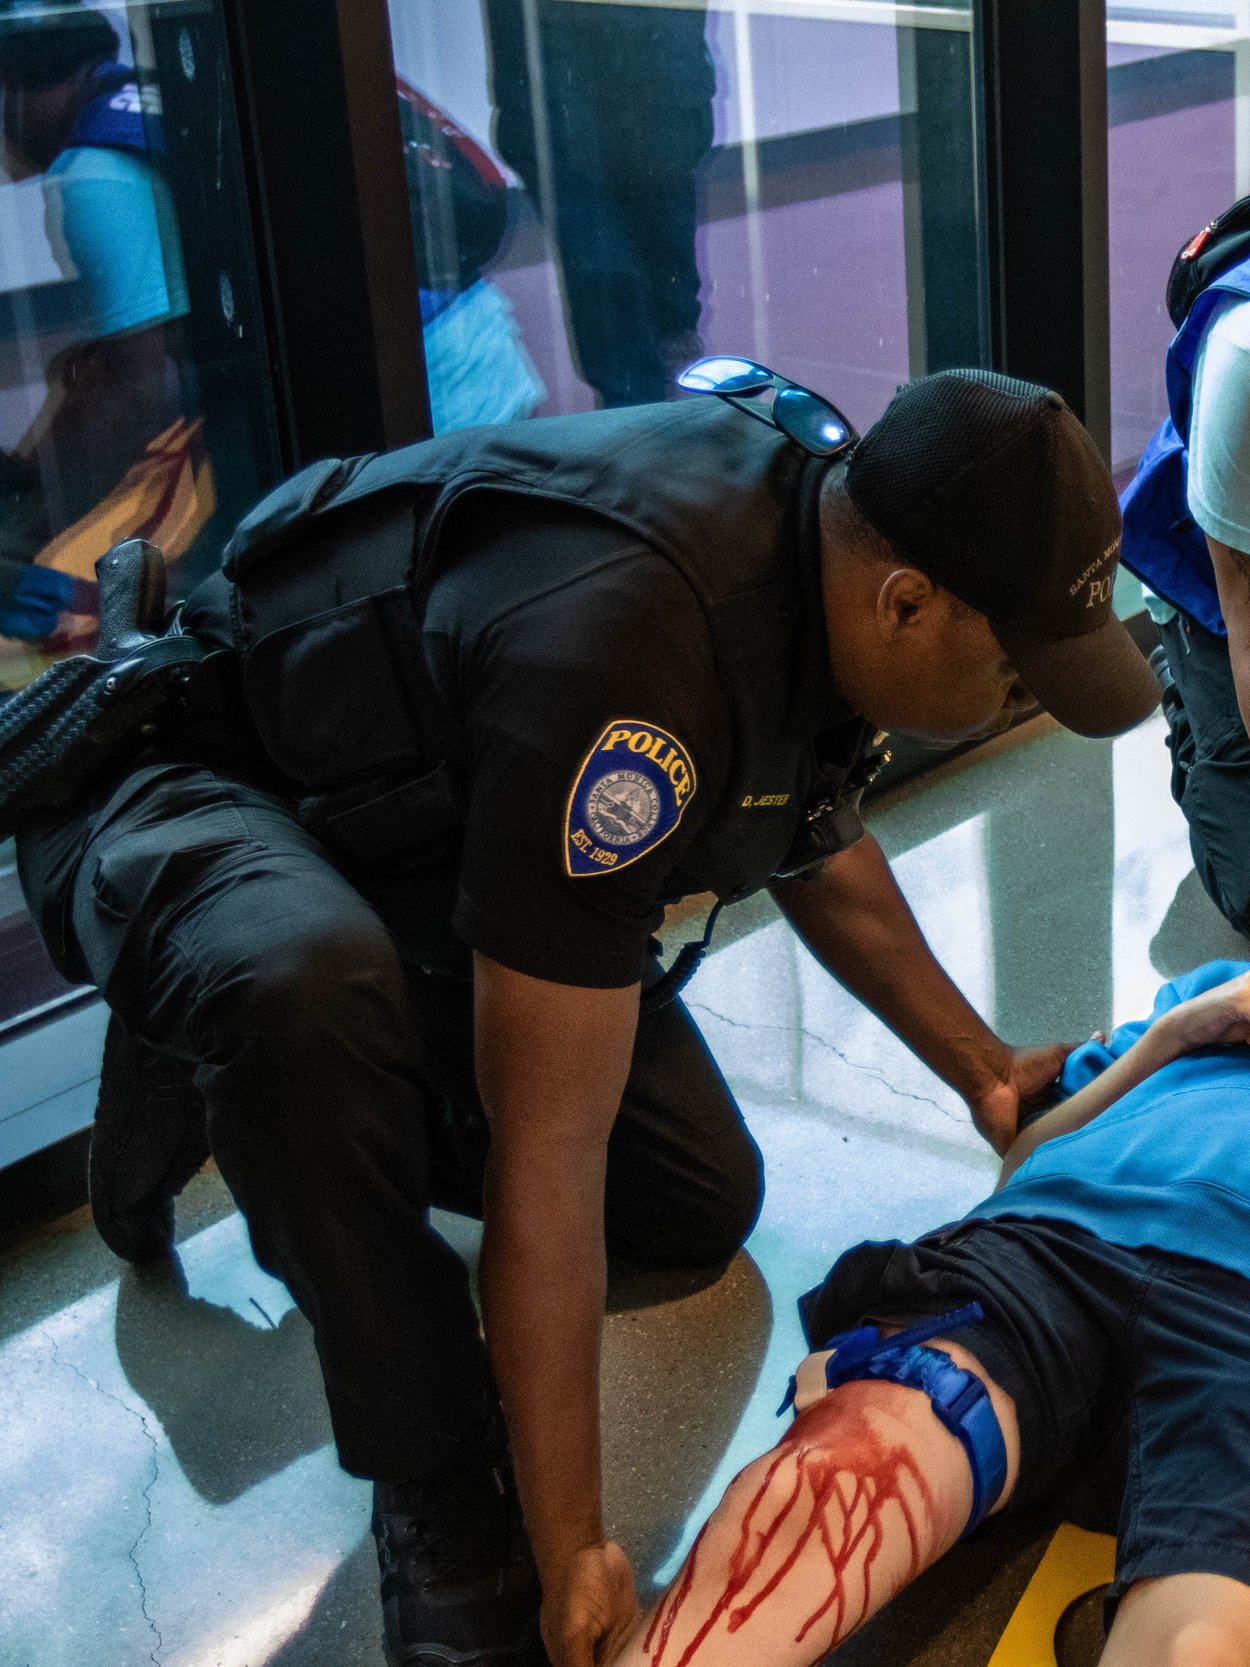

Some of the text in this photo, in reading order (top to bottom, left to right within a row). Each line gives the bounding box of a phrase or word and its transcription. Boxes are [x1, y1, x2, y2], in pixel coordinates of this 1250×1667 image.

[1069, 538, 1120, 595] SANTA MON
[1086, 576, 1111, 608] PO
[601, 730, 690, 806] POLICE
[753, 794, 789, 806] JESTER
[571, 829, 618, 867] EST. 1929
